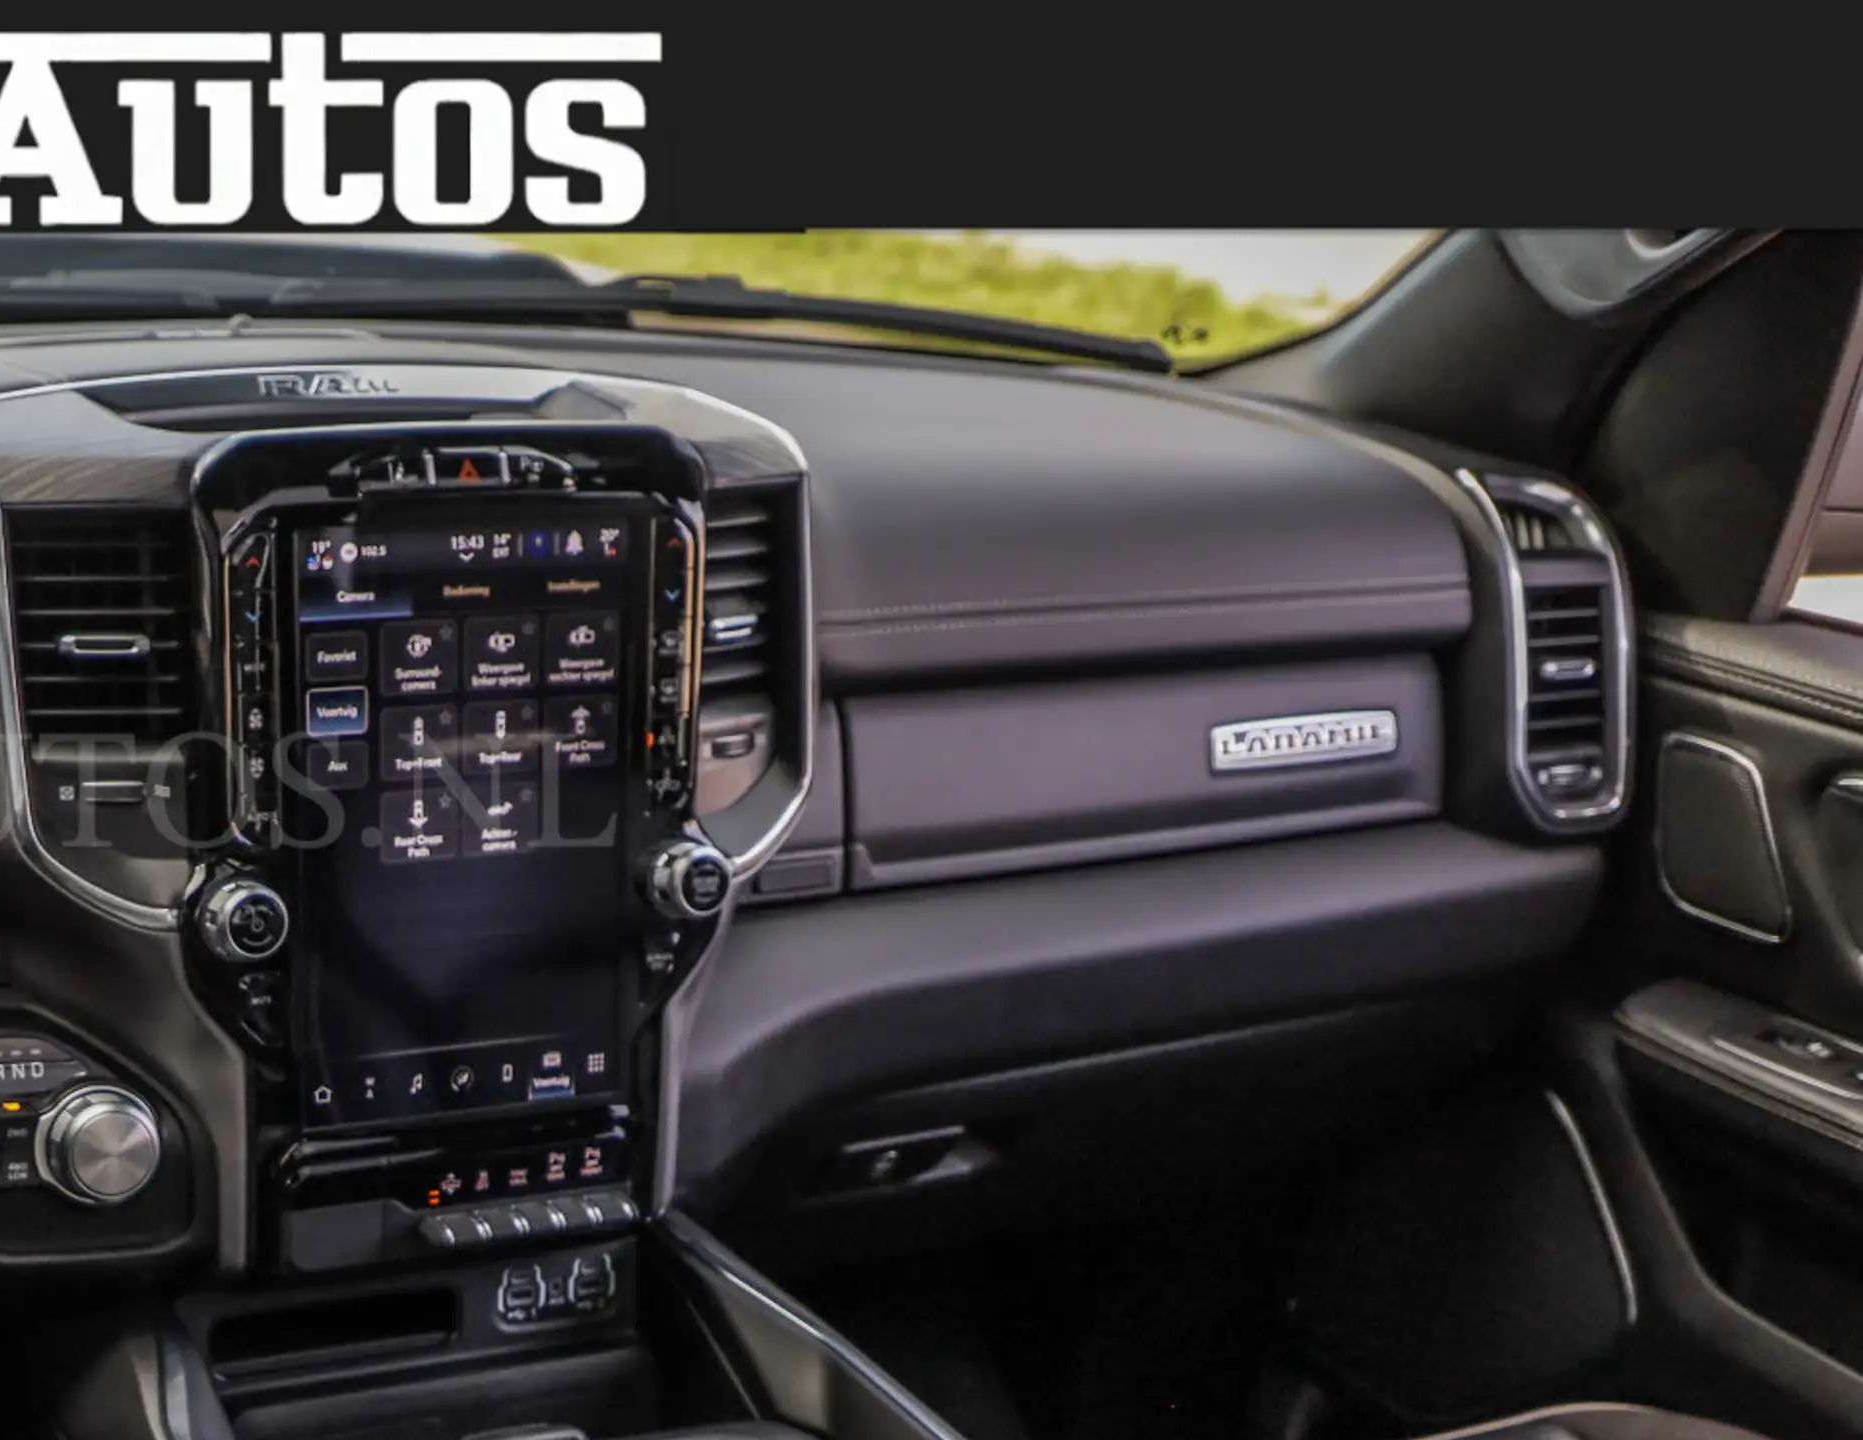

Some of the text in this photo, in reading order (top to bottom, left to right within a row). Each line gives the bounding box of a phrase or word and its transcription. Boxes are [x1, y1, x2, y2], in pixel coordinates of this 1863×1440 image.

[450, 535, 485, 550] 15:43
[337, 590, 376, 602] Camera
[327, 759, 349, 773] Aux
[11, 1064, 26, 1079] N
[31, 1062, 44, 1078] D
